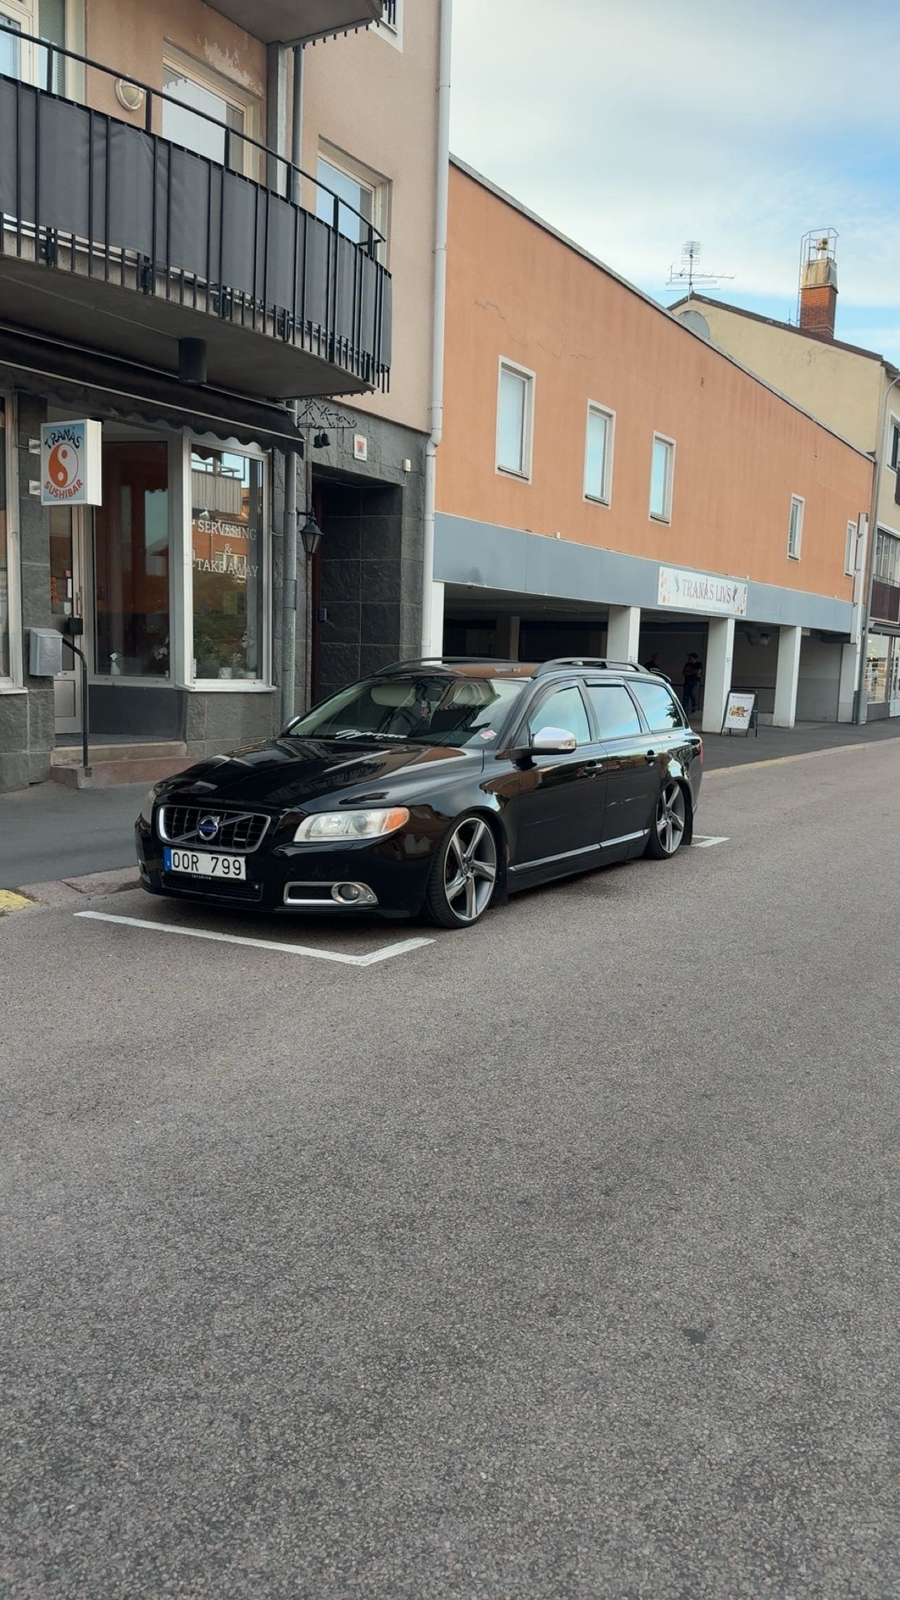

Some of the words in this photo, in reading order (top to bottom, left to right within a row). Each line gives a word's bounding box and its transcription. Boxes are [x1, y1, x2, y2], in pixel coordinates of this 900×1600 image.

[45, 427, 82, 449] TRANÅS
[44, 479, 83, 499] SUSHIBAR
[197, 519, 257, 540] SERVERING
[224, 543, 232, 555] &
[682, 578, 714, 601] TRANÅS
[716, 584, 731, 604] LIVS
[172, 851, 199, 872] OOR
[210, 856, 242, 876] 799
